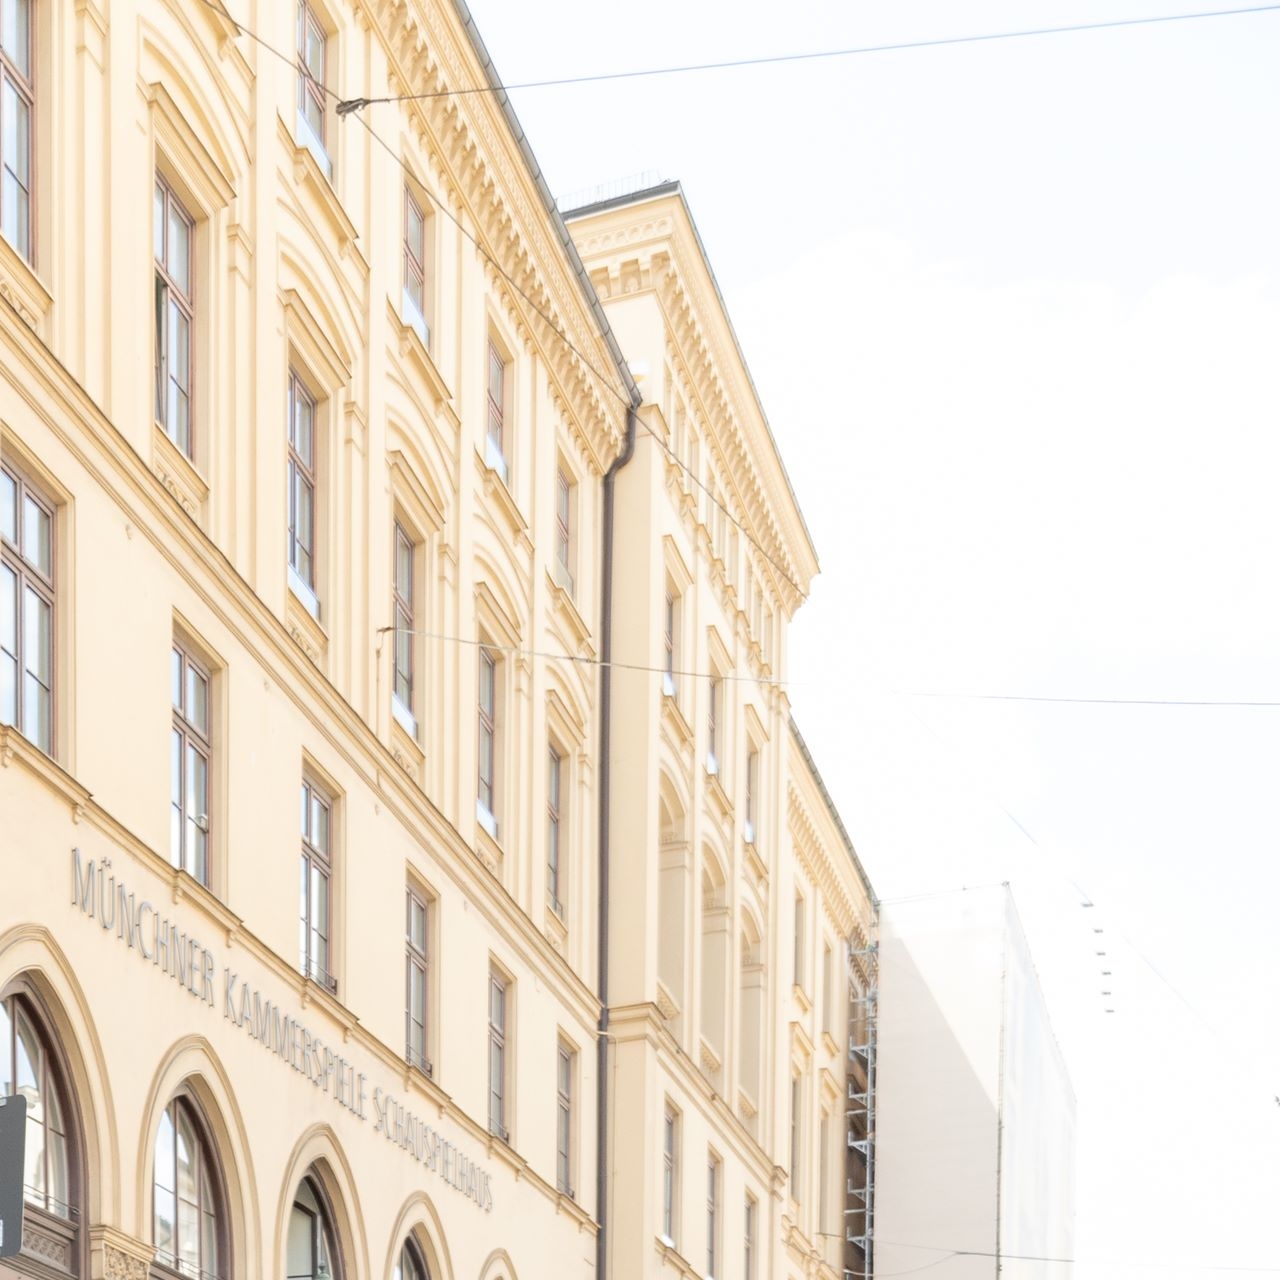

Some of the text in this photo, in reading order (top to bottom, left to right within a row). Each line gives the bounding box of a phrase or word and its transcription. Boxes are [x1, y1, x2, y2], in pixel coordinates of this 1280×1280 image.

[71, 847, 493, 1213] MÜNCHNER KAMMERSPIELE SCHAUSPIELHAUS
